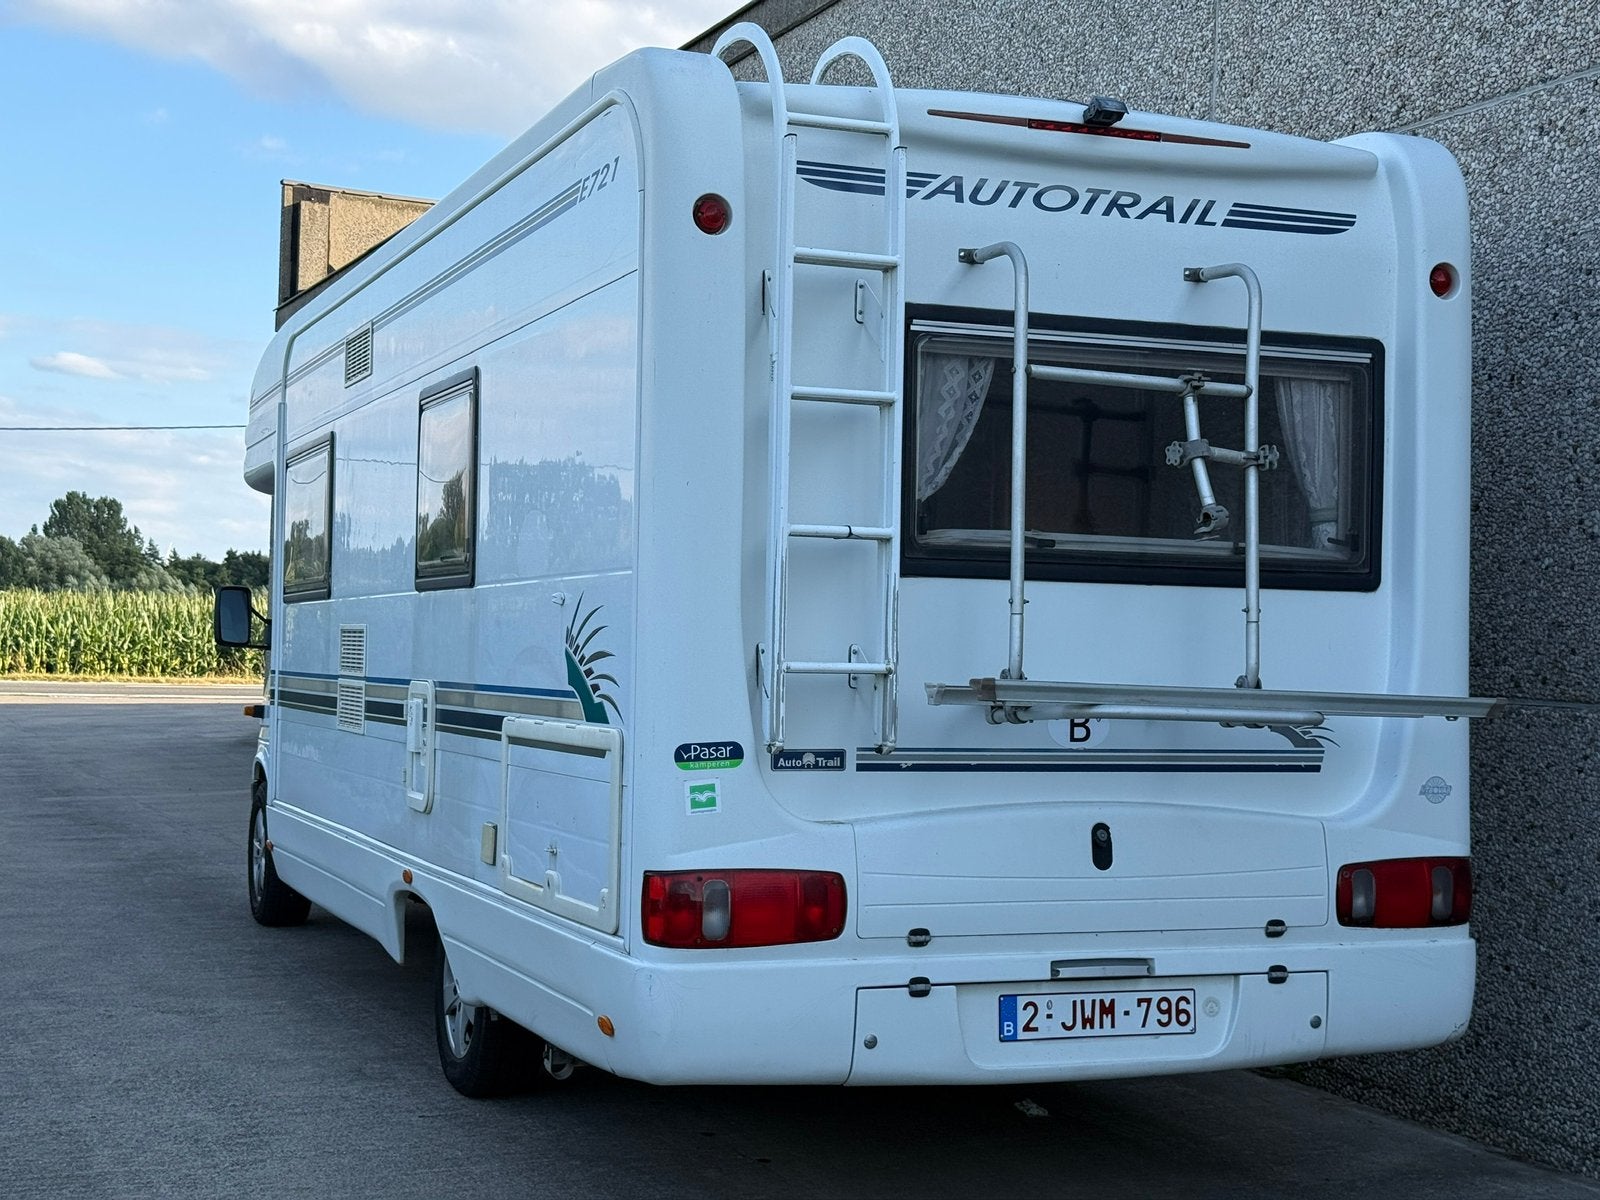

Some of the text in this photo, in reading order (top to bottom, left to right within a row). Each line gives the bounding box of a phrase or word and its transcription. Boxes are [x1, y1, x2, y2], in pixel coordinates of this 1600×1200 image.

[579, 155, 620, 203] E721
[921, 175, 1218, 227] AUTOTRAIL
[1069, 717, 1092, 743] B
[691, 744, 734, 760] Pasar
[777, 757, 841, 768] Auto Trail
[1003, 1021, 1014, 1036] B
